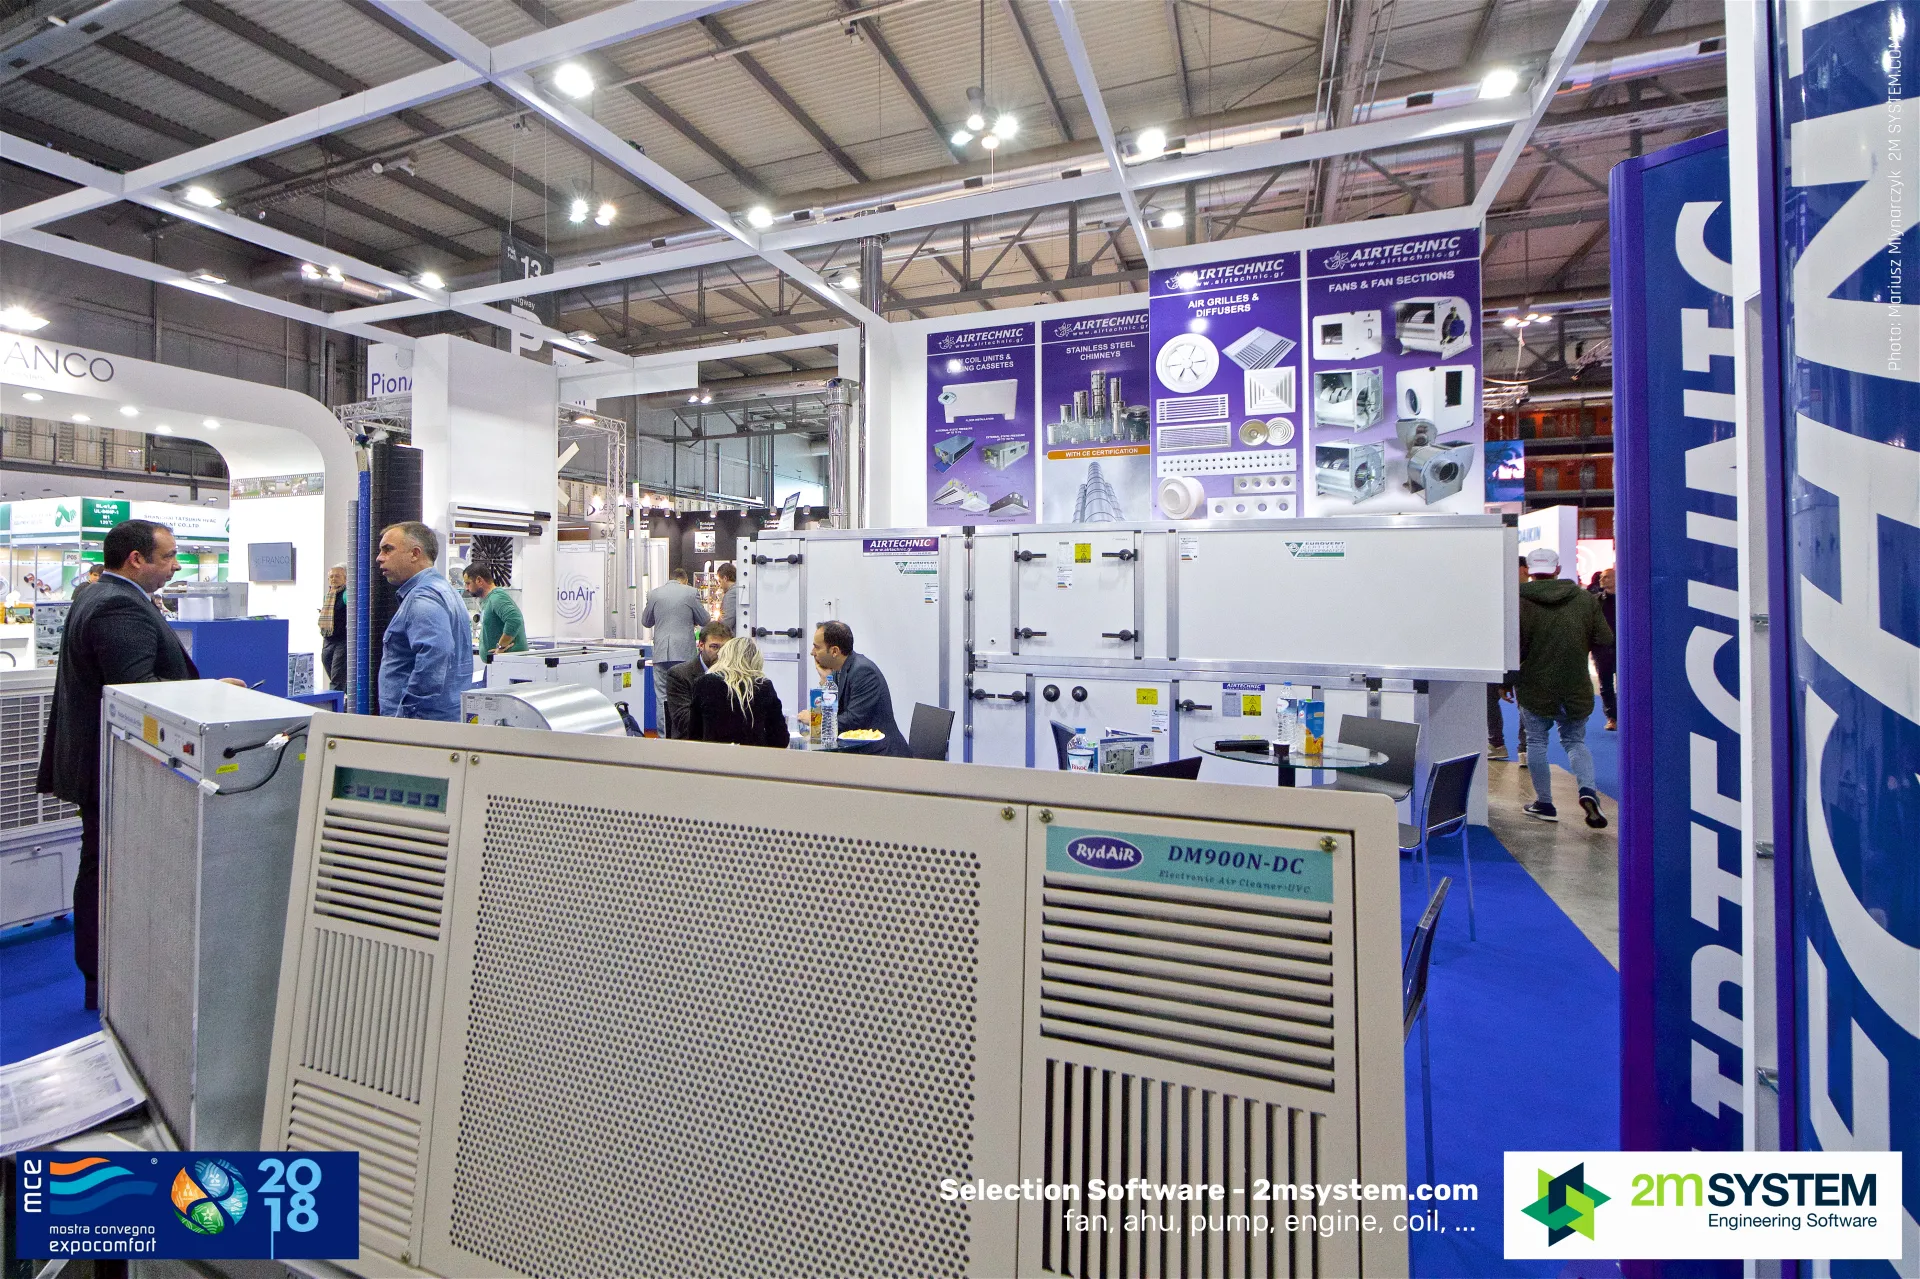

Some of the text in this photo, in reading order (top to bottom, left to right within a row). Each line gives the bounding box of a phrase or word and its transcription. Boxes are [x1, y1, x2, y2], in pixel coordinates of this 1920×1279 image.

[1350, 236, 1461, 261] AIRTECHNIC
[520, 255, 542, 279] 13
[1350, 250, 1460, 268] www.airtechnic.gr
[1191, 259, 1284, 280] AIRTECHNIC
[1194, 271, 1284, 288] ww.airtechnic.gr
[1328, 270, 1455, 292] FANS & FAN SECTIONS
[1188, 292, 1260, 309] AIR GRILLES &
[1196, 304, 1251, 318] DIFFUSERS
[1072, 324, 1149, 336] www.airtechnic.gr
[1073, 314, 1149, 331] AIRTECHNIC
[955, 328, 1024, 343] AIRTECHNIC
[955, 338, 1024, 348] www.airtechnic.gr
[1066, 341, 1136, 354] STAINLESS STEEL
[1080, 351, 1121, 361] CHIMNEYS
[965, 356, 981, 364] COIL
[982, 354, 1004, 362] UNITS
[976, 361, 1014, 371] CASSETES
[1092, 448, 1138, 456] CERTIFICATION
[869, 539, 931, 548] AIRTECHNIC
[1076, 843, 1136, 863] RydAiR
[1168, 845, 1305, 875] DM900N-DC
[1159, 869, 1215, 883] Electronic
[1219, 876, 1236, 886] Air
